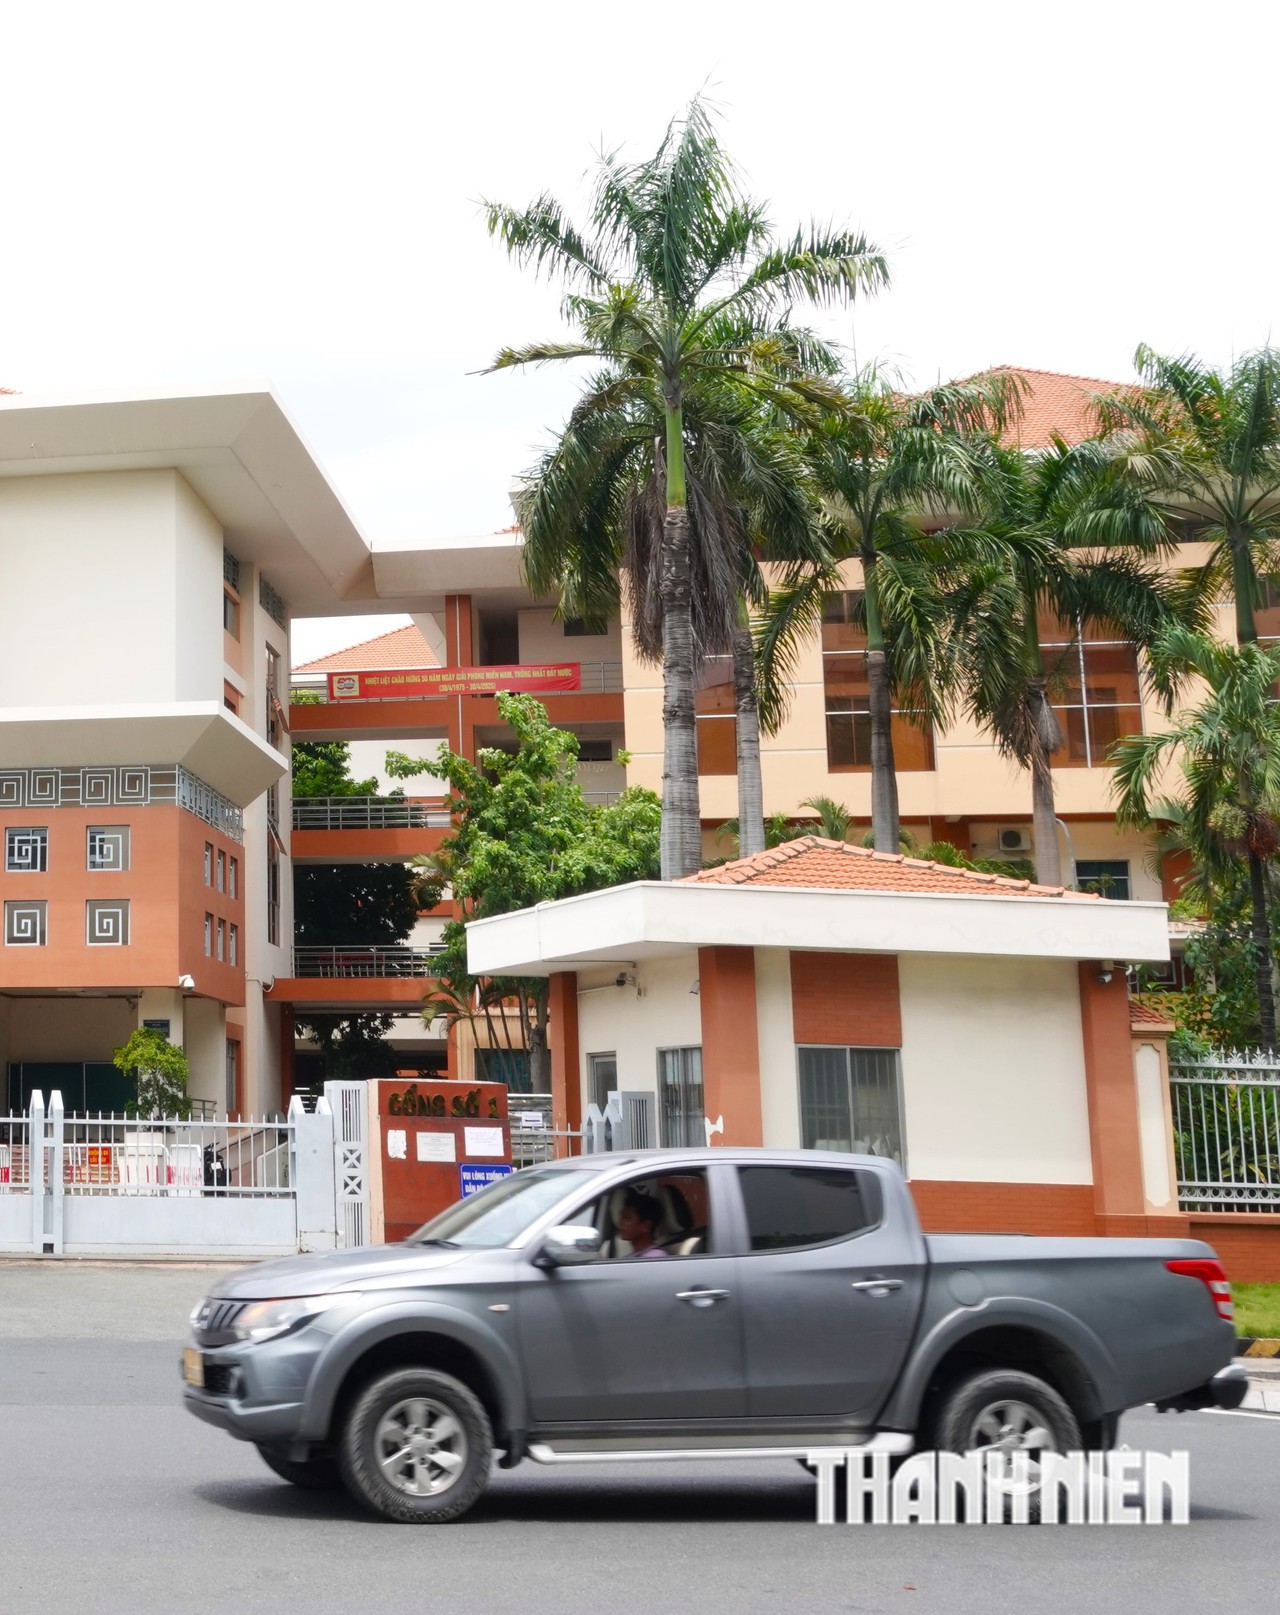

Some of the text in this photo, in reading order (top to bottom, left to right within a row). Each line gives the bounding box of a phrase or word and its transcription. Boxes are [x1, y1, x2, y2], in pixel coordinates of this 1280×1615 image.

[389, 1083, 499, 1119] CỔNG SỐ 1
[462, 1171, 472, 1180] VUI
[472, 1170, 485, 1181] LÒNG
